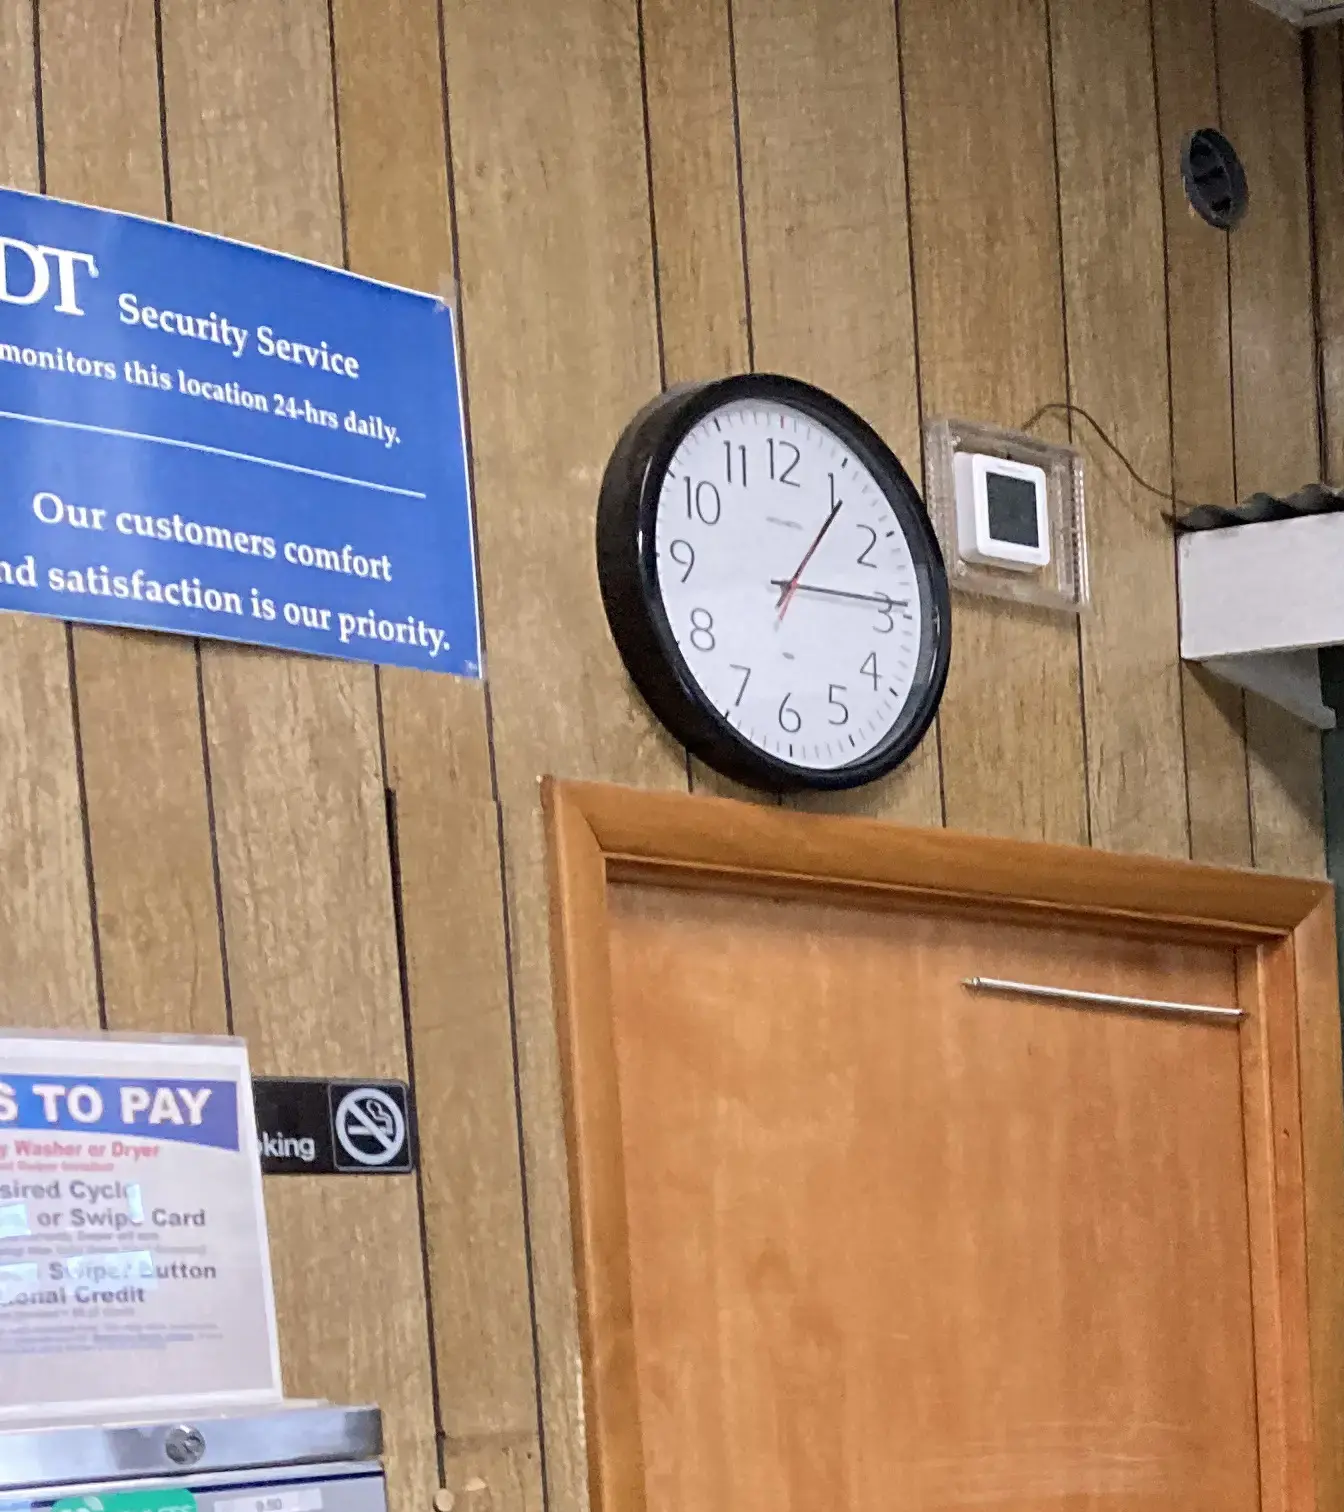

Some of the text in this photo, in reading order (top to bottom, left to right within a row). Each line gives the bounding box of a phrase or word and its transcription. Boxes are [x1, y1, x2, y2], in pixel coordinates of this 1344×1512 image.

[0, 236, 99, 316] DT
[117, 294, 360, 378] Security Service
[0, 343, 401, 447] monitors this location 24-hrs daily.
[723, 440, 747, 487] 11
[766, 438, 801, 487] 12
[683, 476, 721, 525] 10
[33, 492, 393, 582] Our customers comfort
[856, 523, 877, 569] 2
[670, 539, 695, 583] 9
[0, 555, 451, 656] nd satisfaction is our priority.
[689, 608, 715, 652] 8
[729, 664, 751, 706] 7
[859, 651, 882, 691] 4
[778, 692, 801, 733] 6
[828, 684, 848, 725] 5
[32, 1084, 104, 1123] TO
[120, 1086, 213, 1126] PAY
[0, 1180, 61, 1199] sired
[152, 1208, 206, 1227] Card
[74, 1285, 145, 1304] Credit
